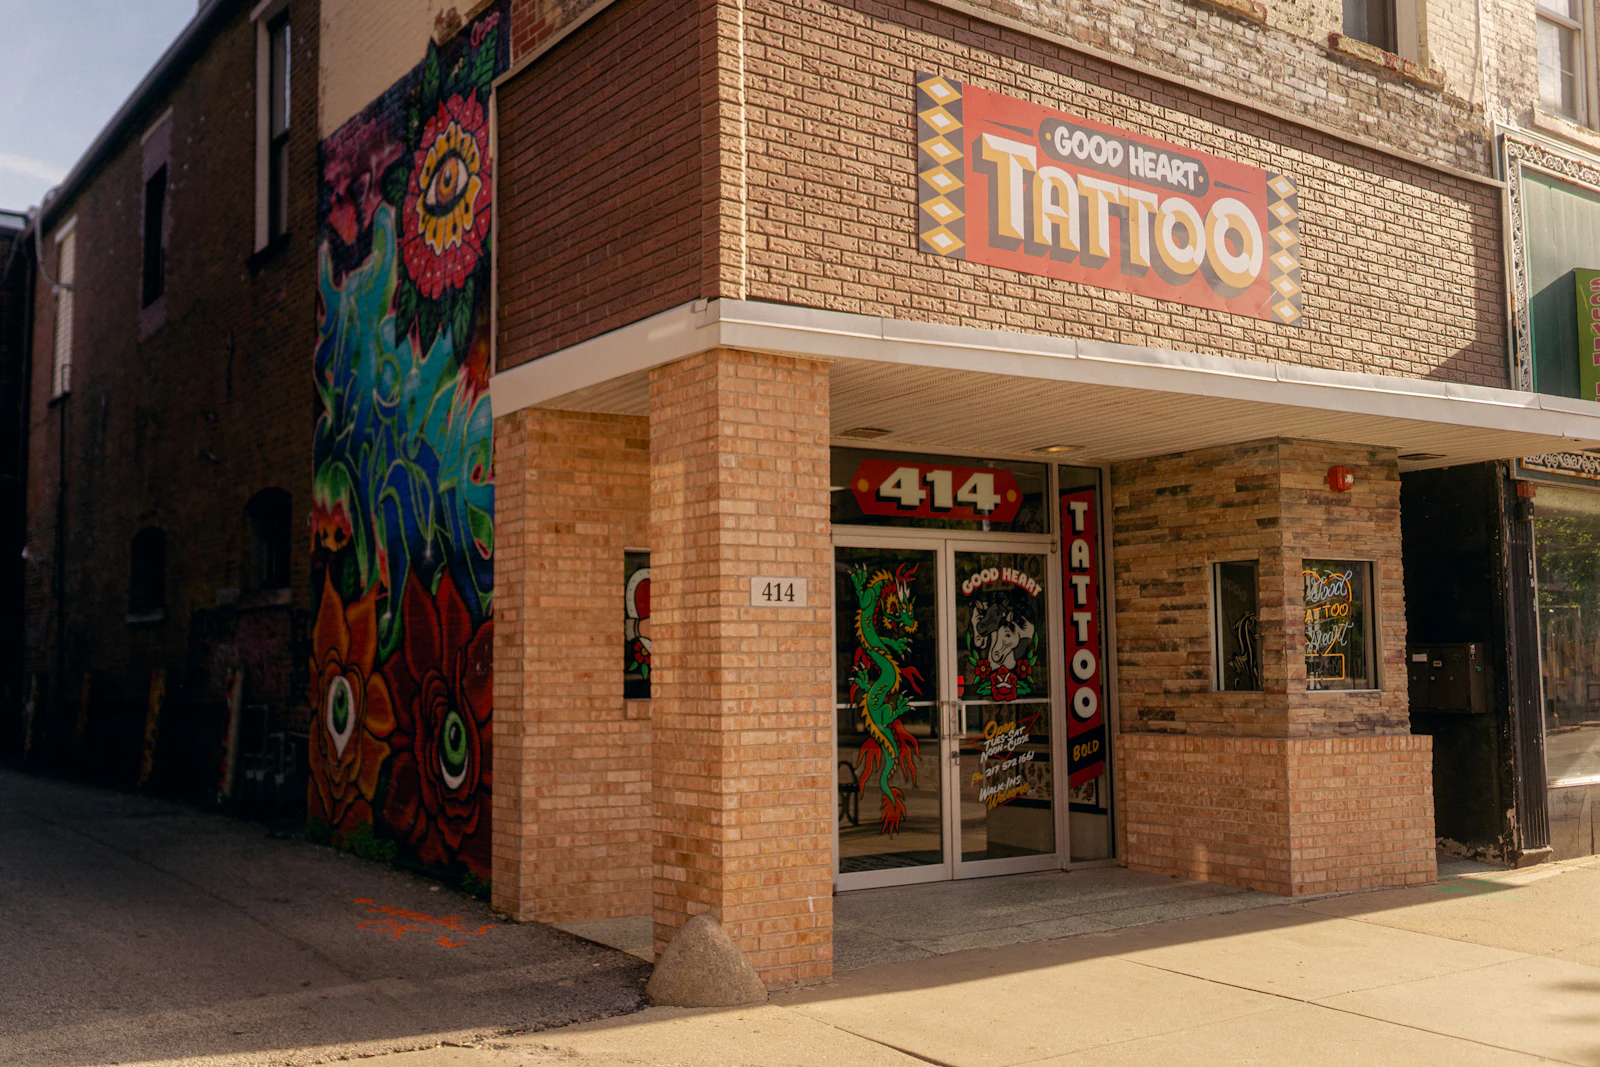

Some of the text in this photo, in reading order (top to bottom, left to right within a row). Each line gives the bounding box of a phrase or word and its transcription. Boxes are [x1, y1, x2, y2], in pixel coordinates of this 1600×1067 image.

[1054, 125, 1199, 191] GOOD HEART
[979, 132, 1264, 290] TATTOO
[878, 466, 1001, 511] 414
[762, 582, 795, 602] 414
[962, 567, 1043, 598] GOOD HEART
[1069, 501, 1098, 719] TATTOO
[1304, 603, 1349, 623] ATTOO
[984, 720, 1016, 740] Open
[1073, 740, 1099, 761] BOLD
[986, 765, 999, 777] 217
[1001, 758, 1017, 771] 572
